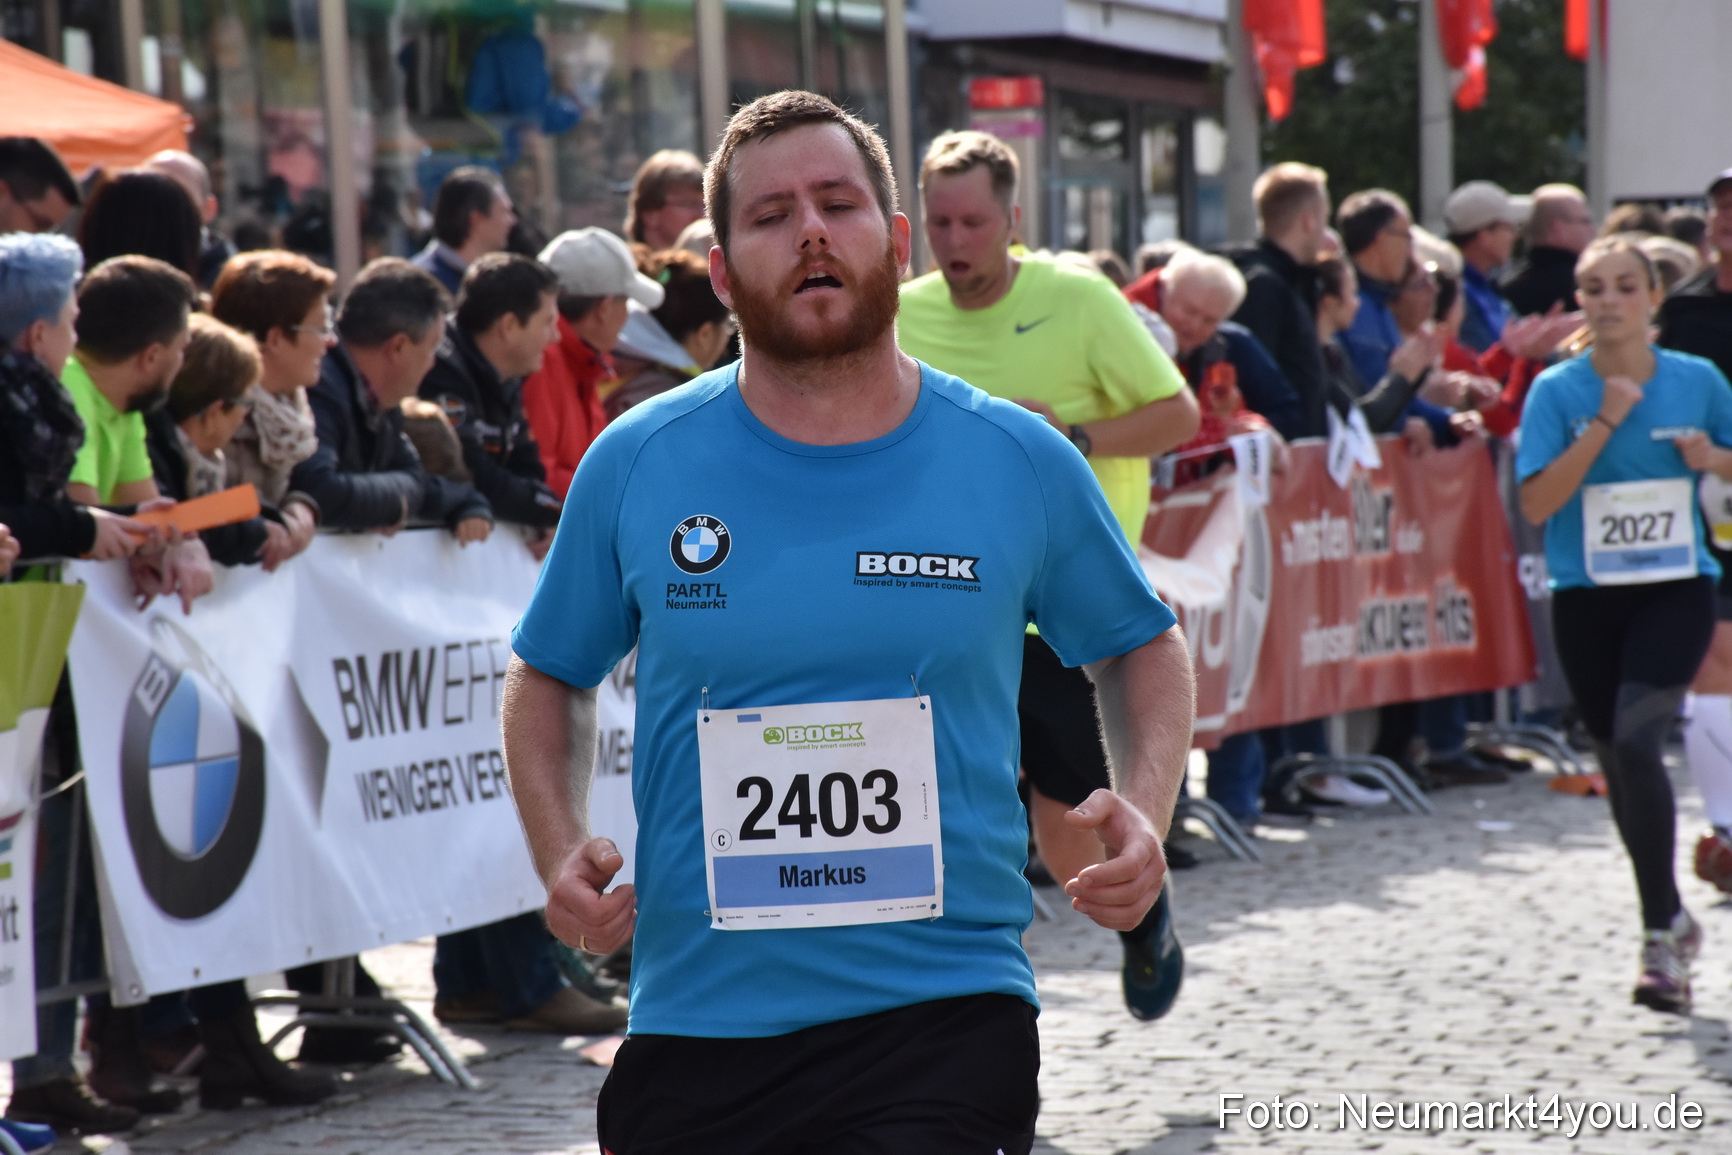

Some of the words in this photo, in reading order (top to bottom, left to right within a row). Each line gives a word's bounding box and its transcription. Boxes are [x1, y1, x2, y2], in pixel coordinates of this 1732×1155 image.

[676, 517, 727, 537] BMW
[1601, 511, 1675, 545] 2027
[856, 552, 981, 582] BOCK
[666, 583, 727, 598] PARTL
[853, 577, 893, 588] inspired
[895, 579, 907, 588] by
[910, 581, 938, 589] smart
[941, 583, 981, 593] concepts
[665, 599, 727, 610] Neumarkt
[332, 646, 437, 741] BMW
[786, 722, 865, 744] BOCK
[787, 743, 811, 751] inspired
[811, 743, 819, 751] by
[820, 742, 838, 750] smart
[839, 741, 866, 749] concepts
[354, 759, 459, 824] WENIGER
[736, 768, 902, 841] 2403
[717, 834, 726, 847] C
[779, 863, 867, 888] Markus
